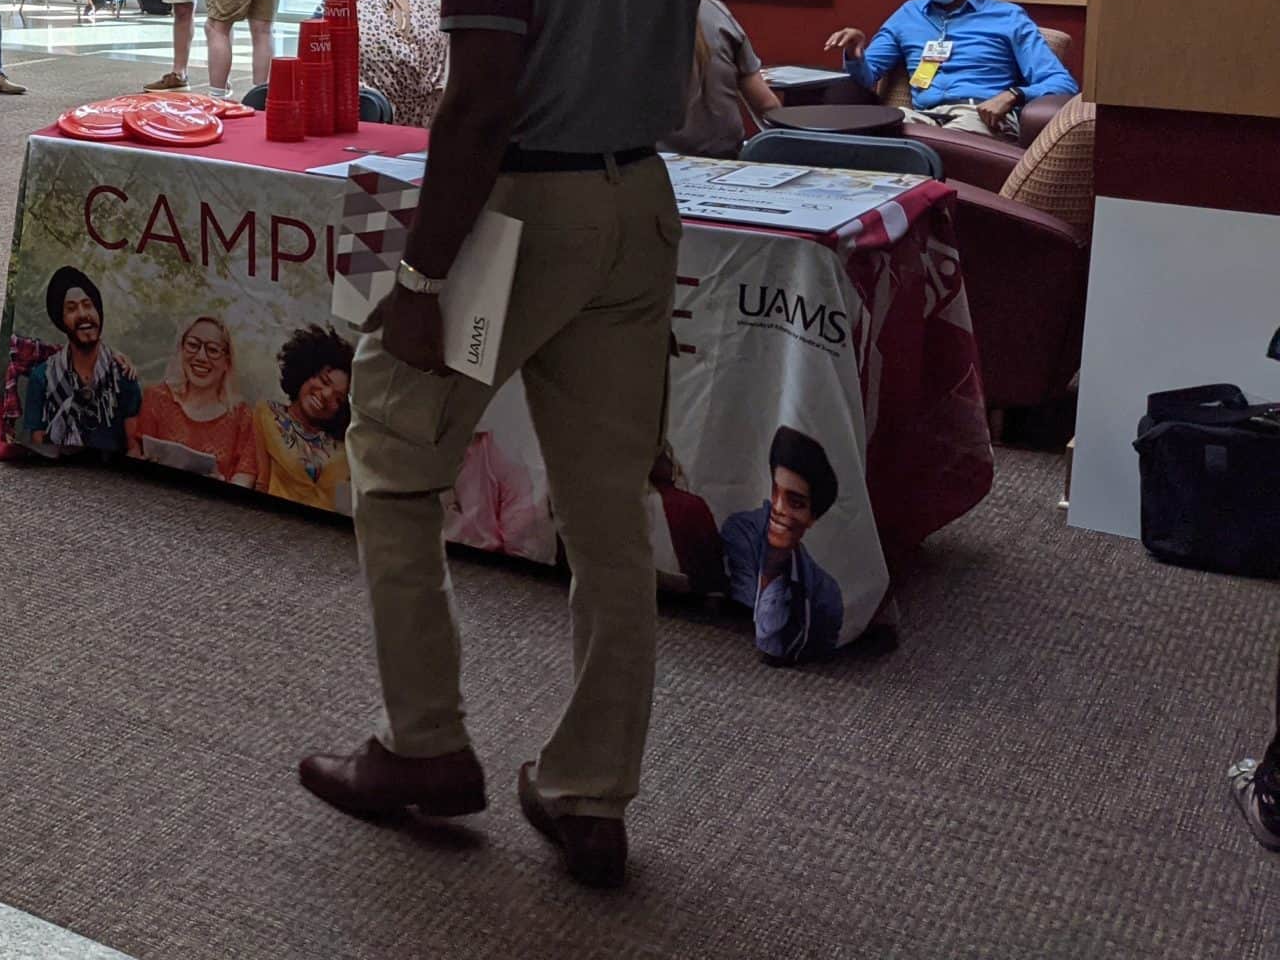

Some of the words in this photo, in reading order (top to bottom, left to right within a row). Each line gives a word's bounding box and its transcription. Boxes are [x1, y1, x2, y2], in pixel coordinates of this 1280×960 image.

[310, 41, 332, 53] AMS
[739, 283, 847, 344] UAMS
[466, 315, 486, 365] UAMS
